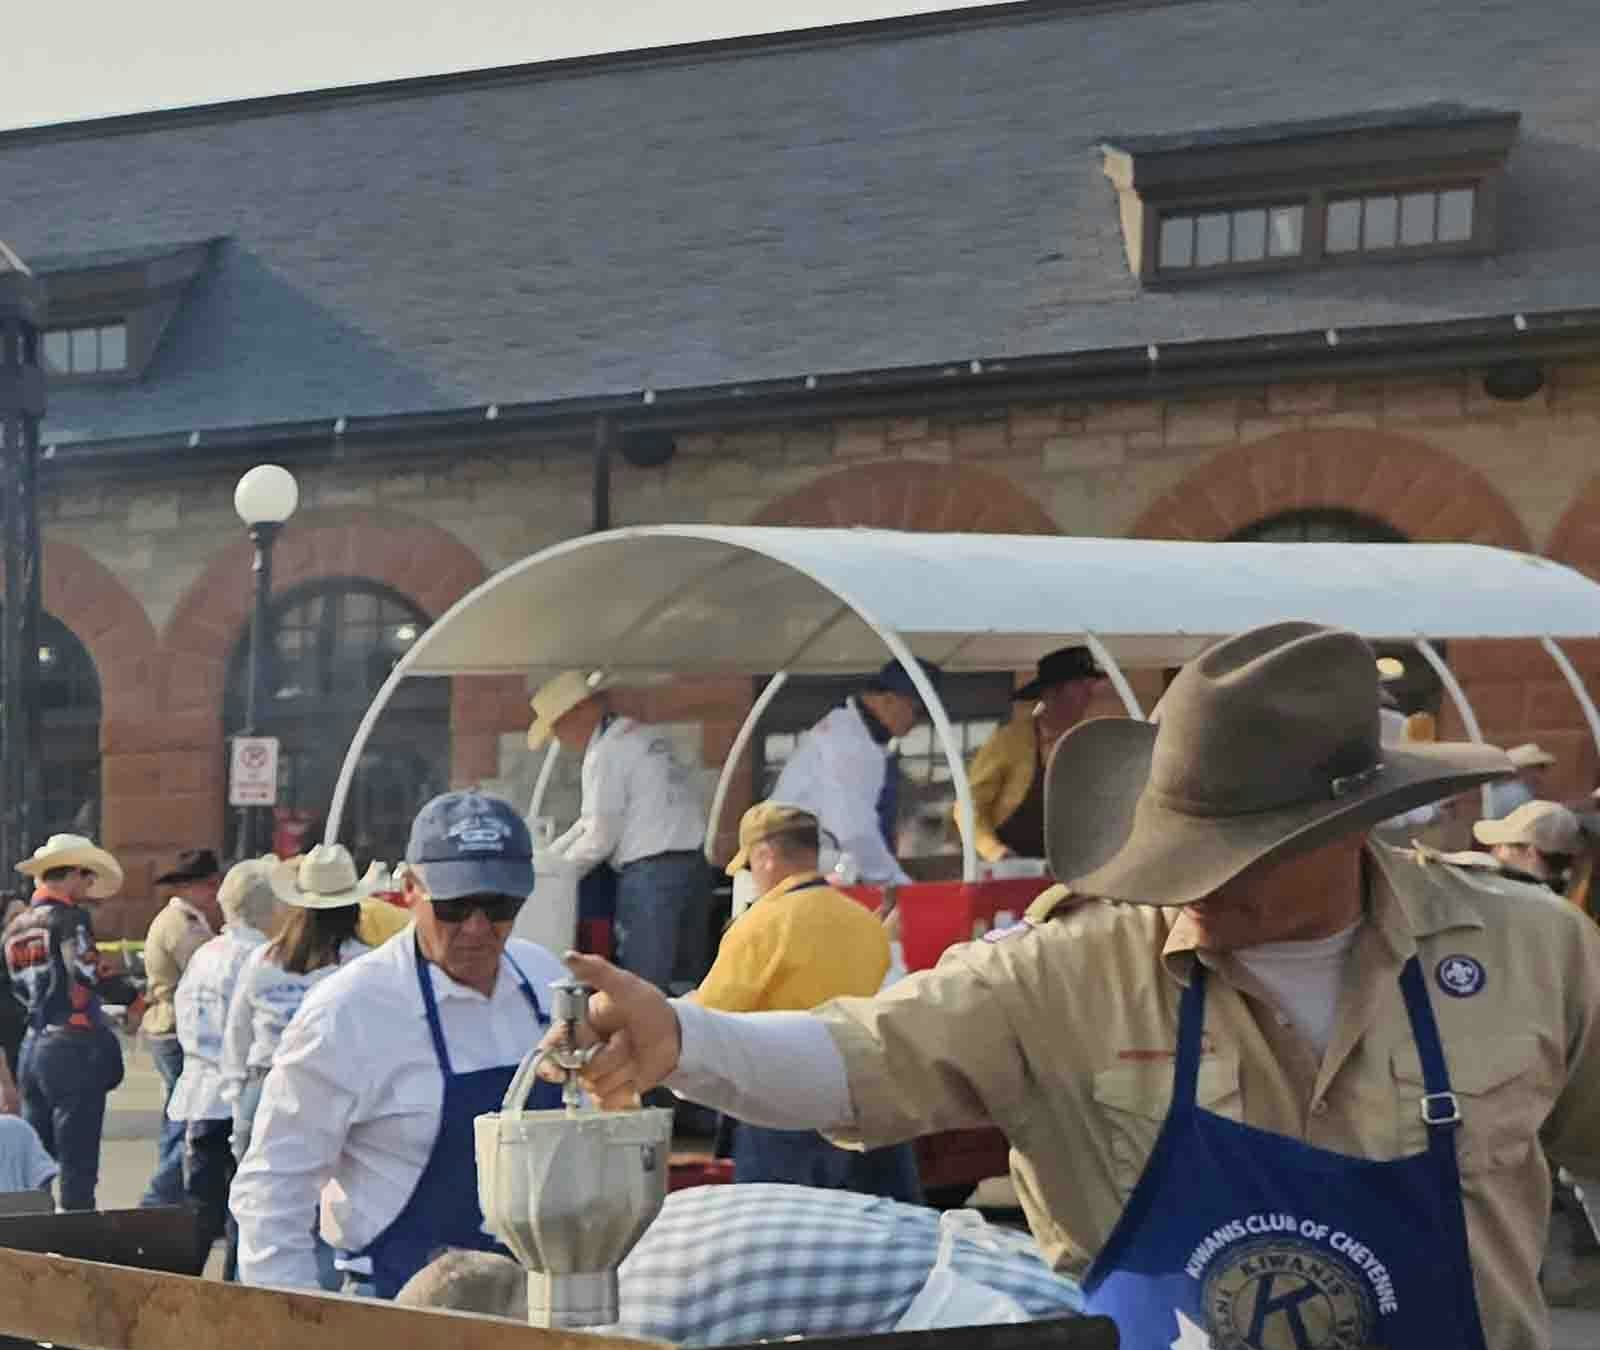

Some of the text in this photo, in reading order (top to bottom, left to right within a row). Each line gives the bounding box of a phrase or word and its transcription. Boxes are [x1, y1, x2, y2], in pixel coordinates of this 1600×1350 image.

[1184, 1213, 1399, 1316] KIWANIS CLUB OF CHEYENNE
